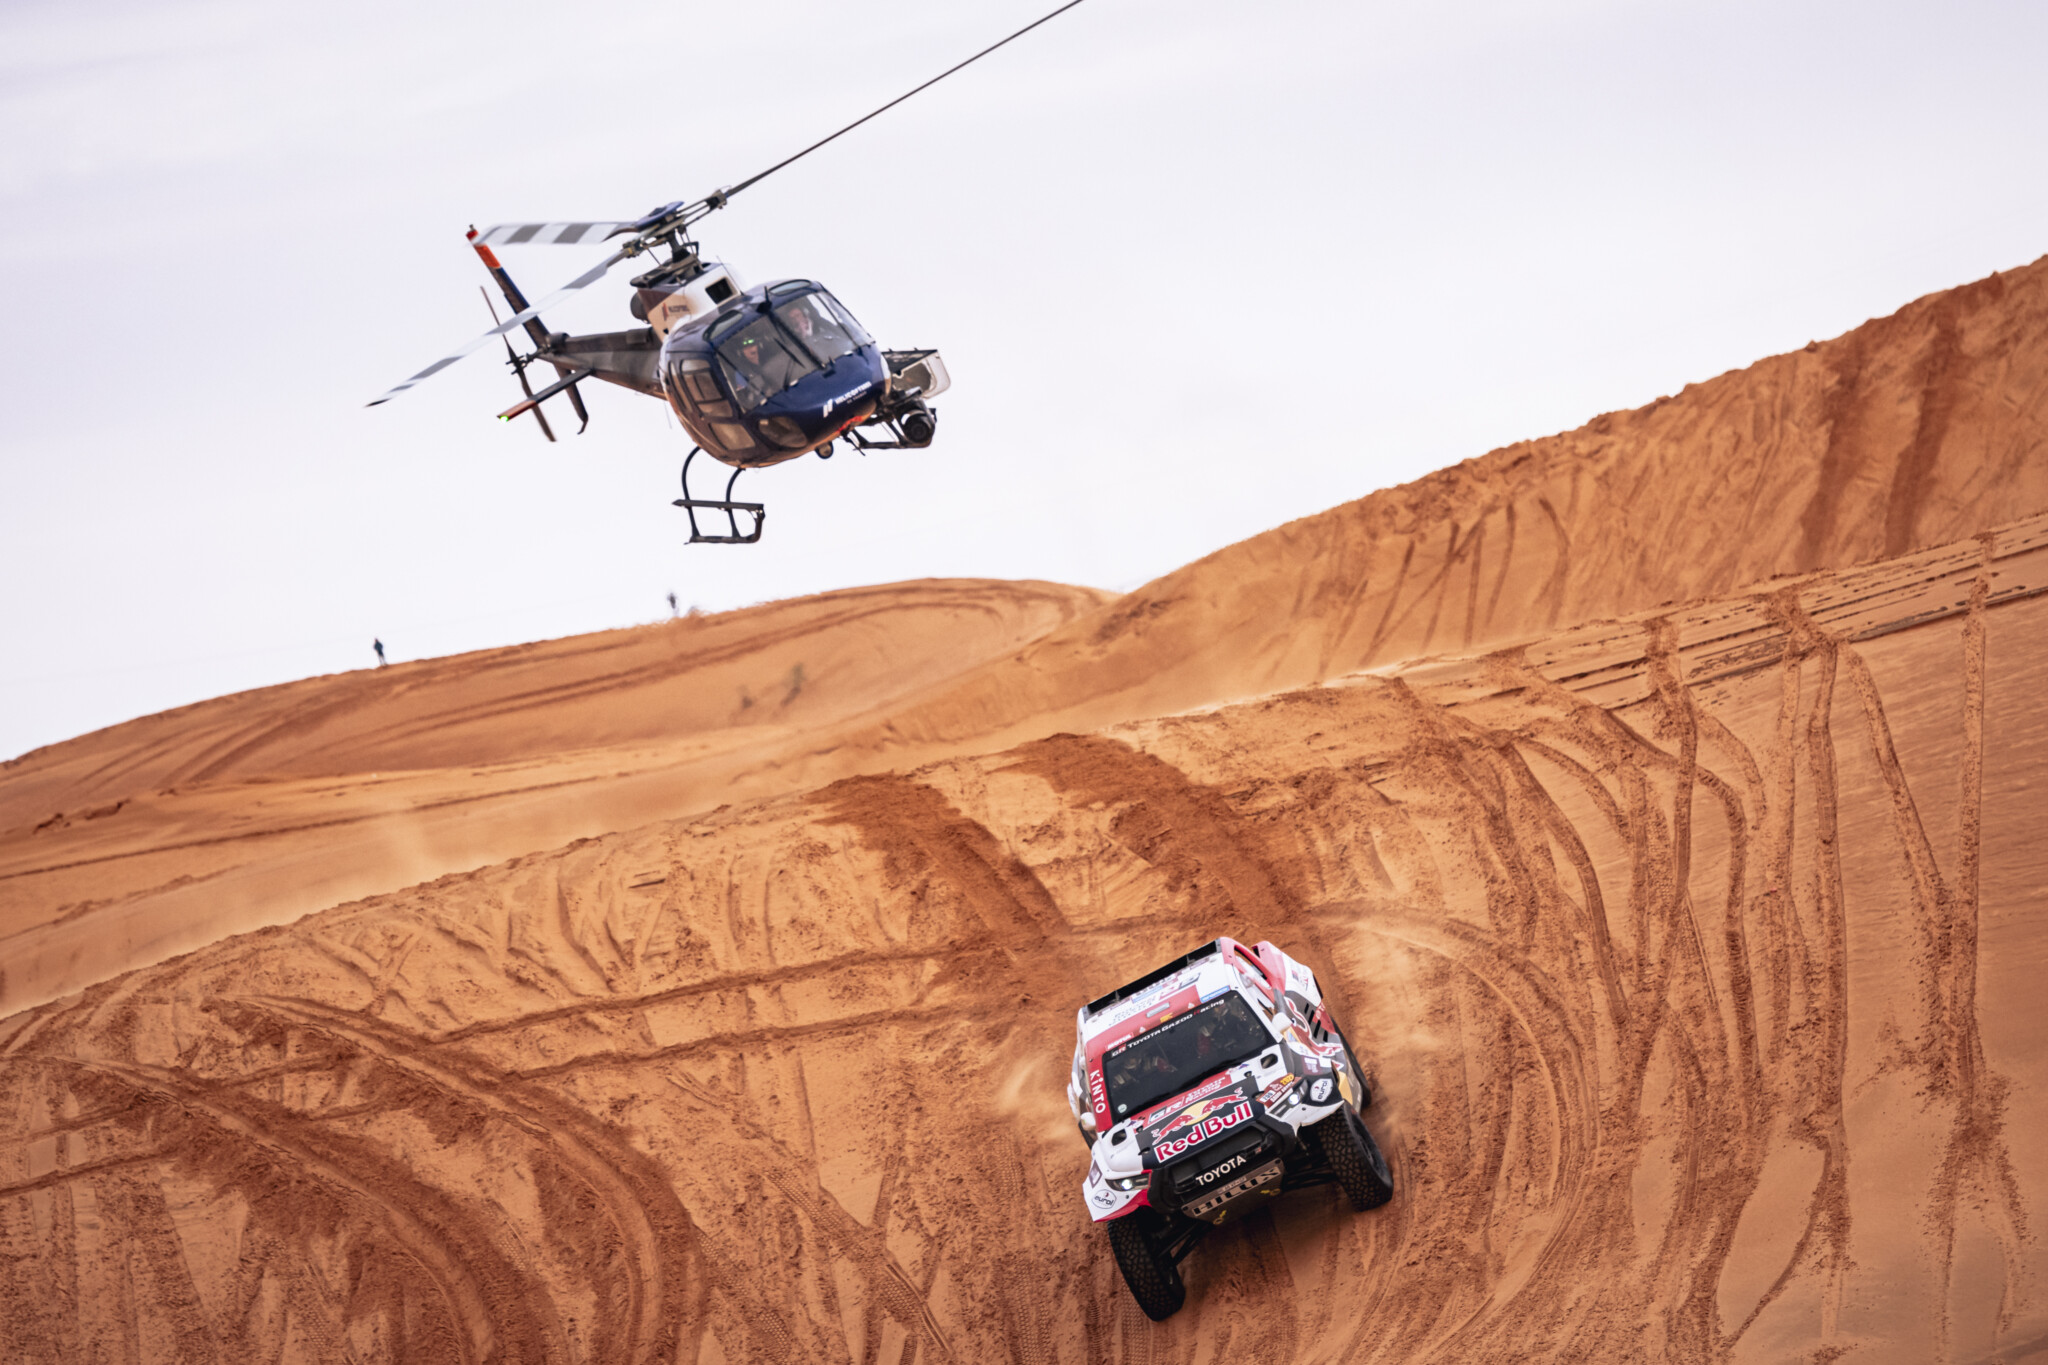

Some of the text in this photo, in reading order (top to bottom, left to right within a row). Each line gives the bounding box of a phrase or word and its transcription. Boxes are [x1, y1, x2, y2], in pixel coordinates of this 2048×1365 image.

[1127, 1030, 1160, 1048] TOYOTA
[1162, 1014, 1193, 1032] GAZOO
[1193, 999, 1225, 1015] Racing
[1155, 1102, 1253, 1162] Red Bull
[1193, 1168, 1279, 1214] HILUX
[1195, 1155, 1247, 1185] TOYOTA
